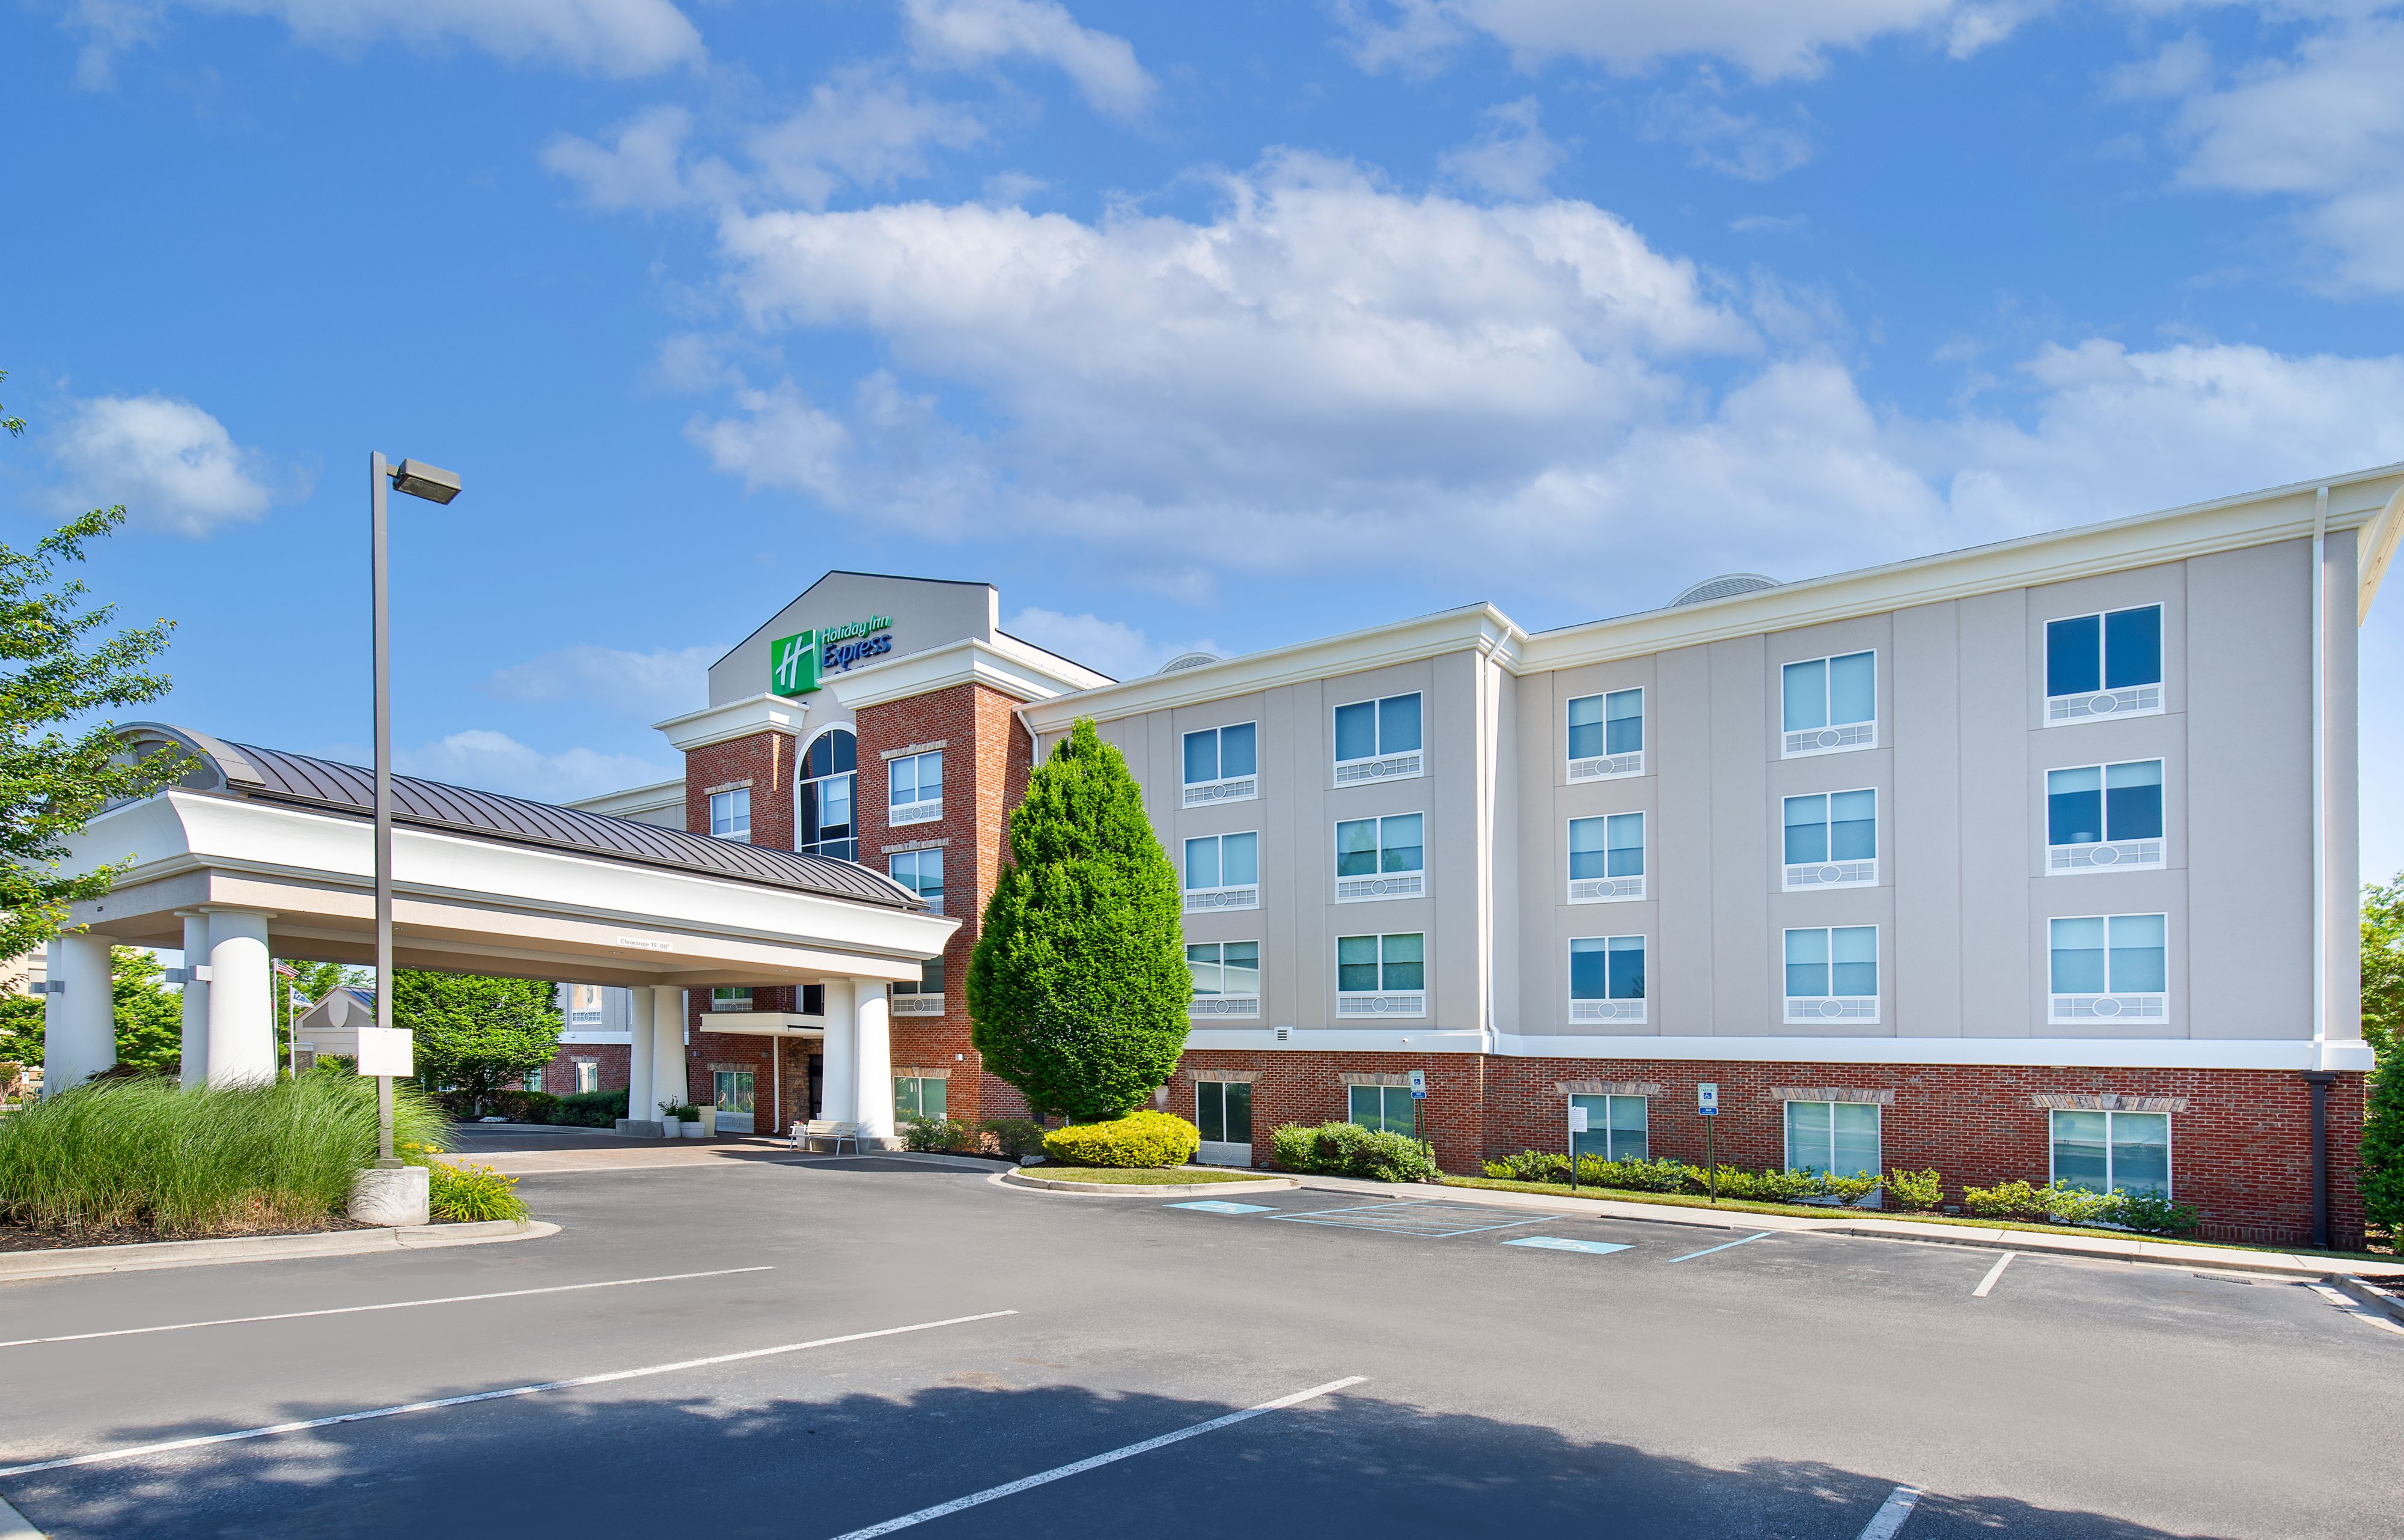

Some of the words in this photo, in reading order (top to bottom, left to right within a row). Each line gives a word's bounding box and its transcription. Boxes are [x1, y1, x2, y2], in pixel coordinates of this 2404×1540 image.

[822, 621, 869, 644] Holiday
[869, 614, 892, 632] Inn
[822, 634, 892, 669] Express
[620, 939, 649, 947] Clearance
